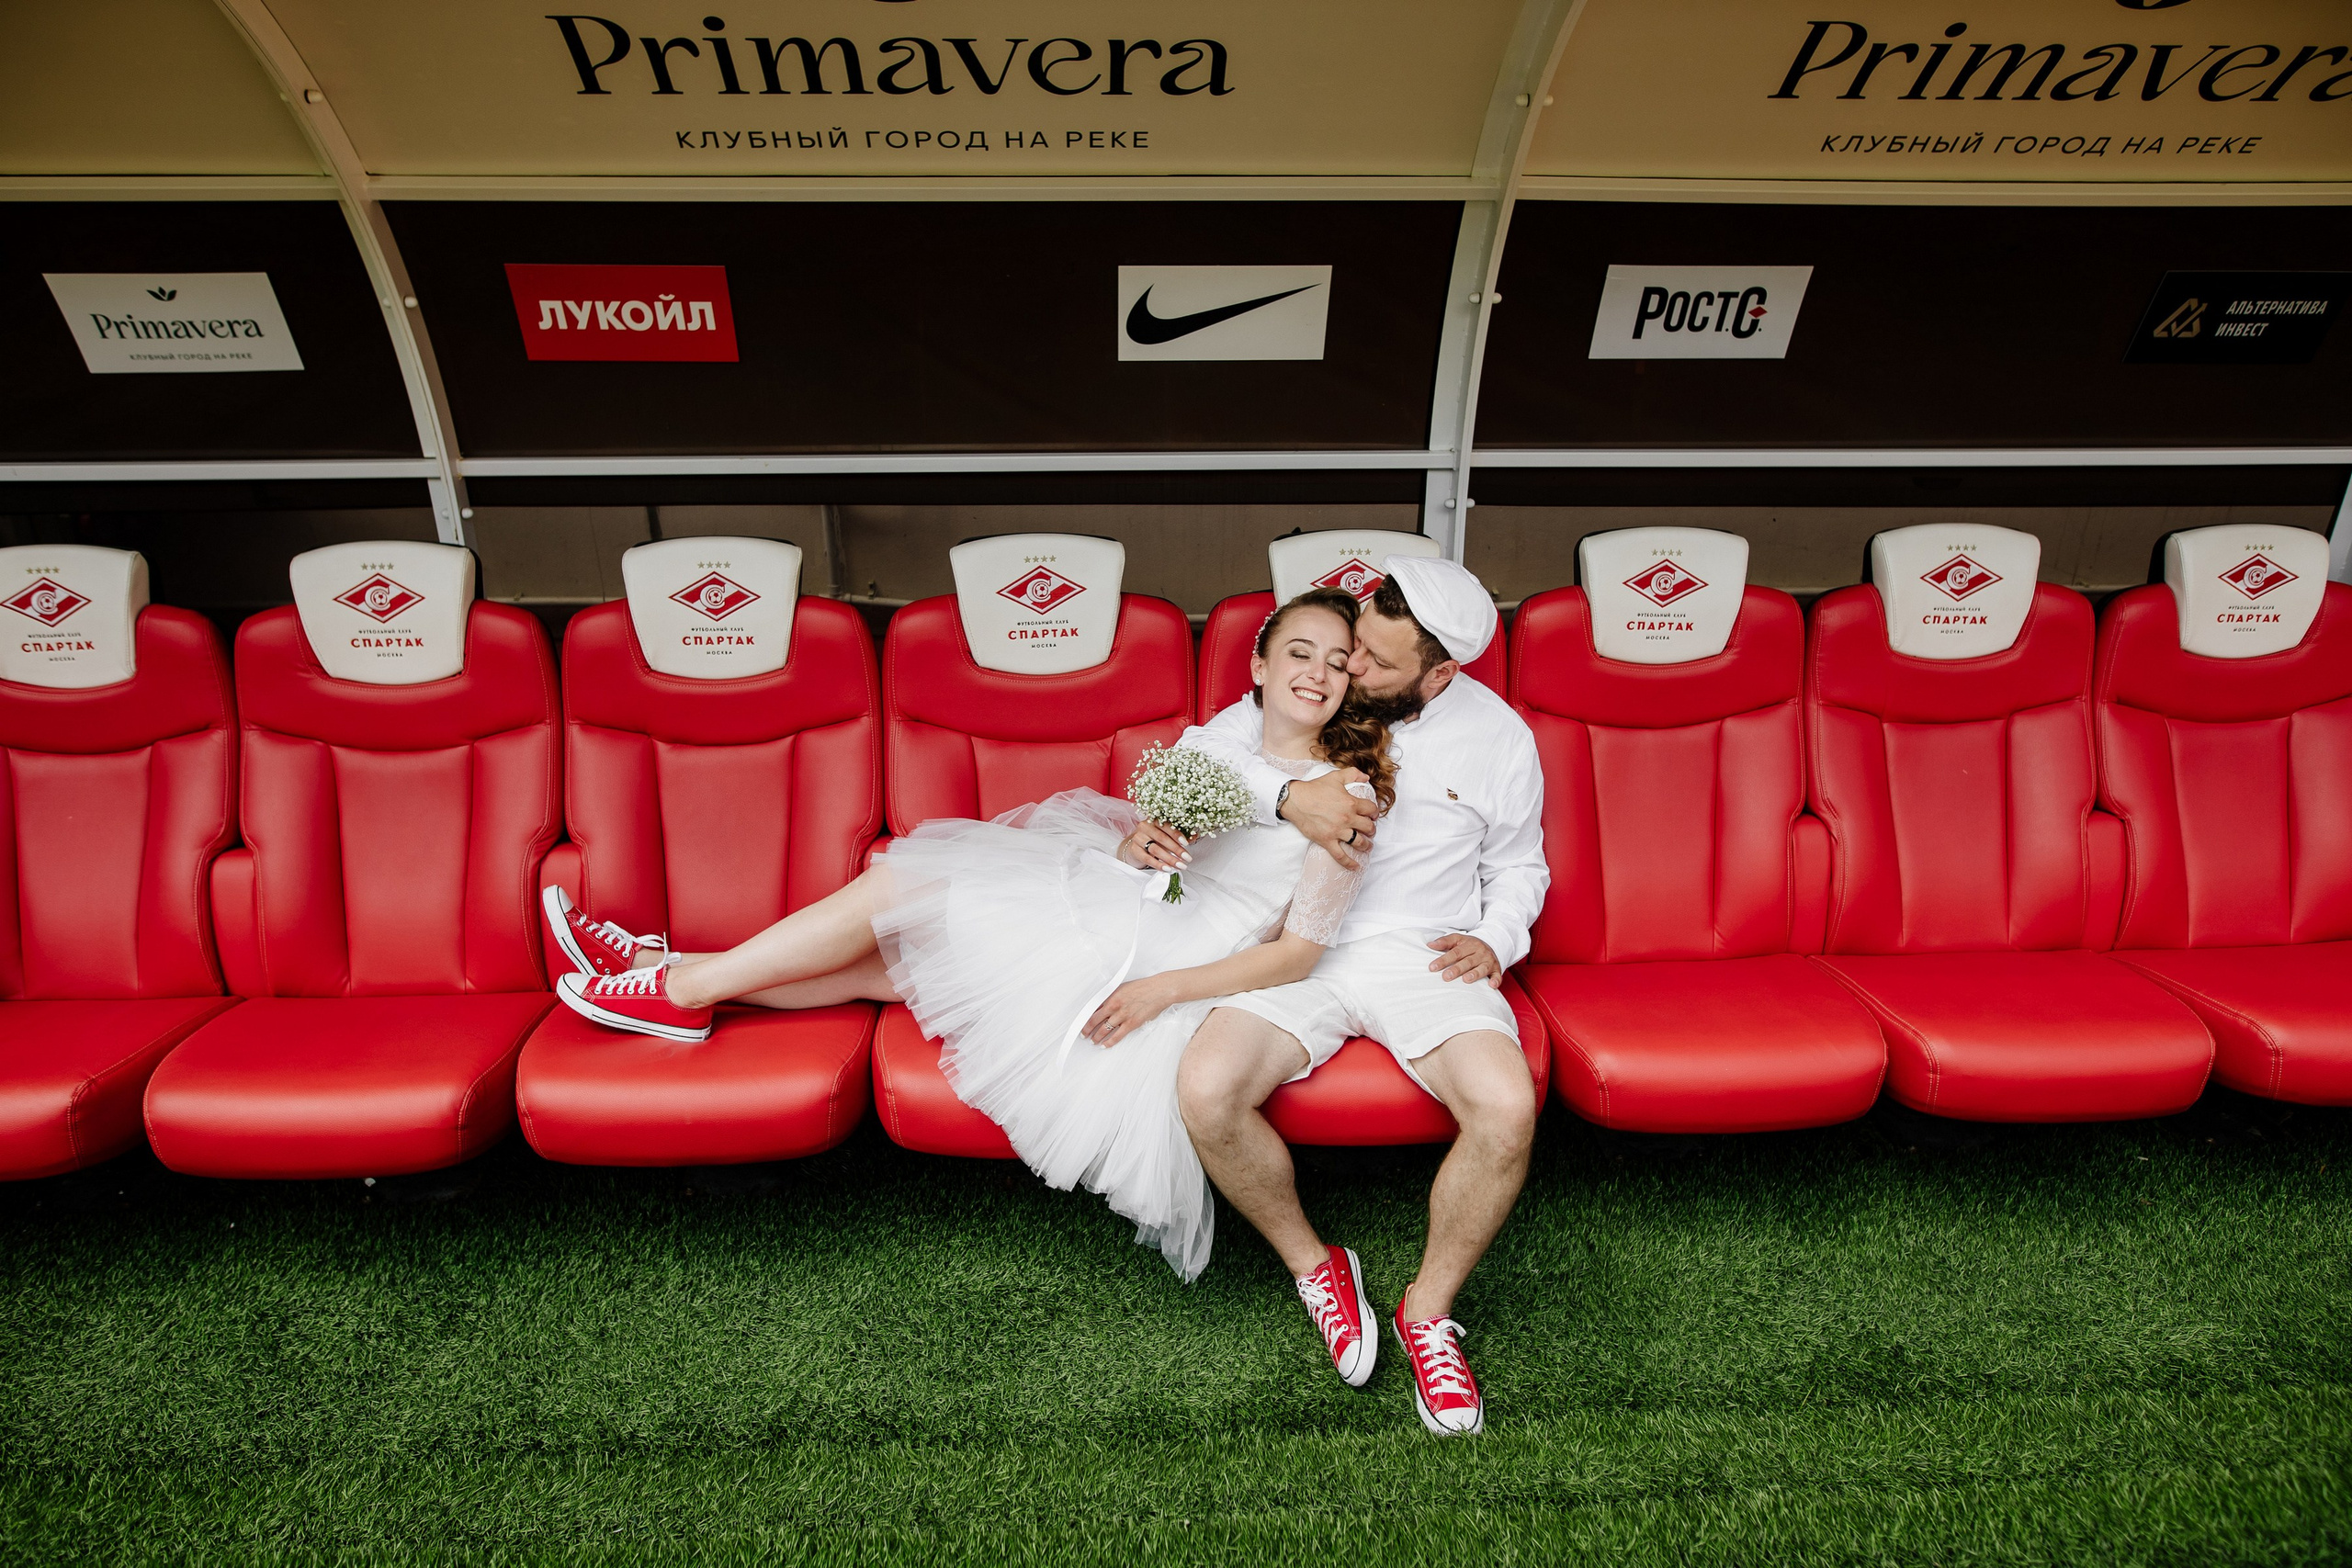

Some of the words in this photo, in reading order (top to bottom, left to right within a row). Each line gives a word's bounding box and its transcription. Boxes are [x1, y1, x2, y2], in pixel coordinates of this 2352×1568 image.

[545, 16, 1235, 96] Primavera
[676, 127, 848, 149] КЛУБНЫЙ
[865, 130, 989, 151] ГОРОД
[1005, 131, 1048, 148] НА
[1067, 131, 1148, 148] РЕКЕ
[1821, 132, 1984, 152] КЛУБНЫЙ
[1994, 136, 2111, 156] ГОРОД
[2121, 137, 2164, 153] НА
[2177, 137, 2262, 153] РЕКЕ
[538, 294, 716, 331] ЛУКОЙЛ
[2226, 301, 2327, 314] АЛЬТЕРНАТИВА
[90, 314, 264, 339] Primavera
[2215, 323, 2268, 336] ИНВЕСТ
[129, 353, 175, 361] КЛУБНЫЙ
[177, 353, 212, 361] ГОРОД
[229, 352, 254, 360] РЕКЕ
[1923, 615, 1987, 624] СПАРТАК
[2217, 615, 2280, 623] СПАРТАК
[1627, 621, 1693, 631] СПАРТАК
[1008, 628, 1079, 639] СПАРТАК
[21, 641, 94, 652] СПАРТАК
[351, 638, 424, 648] СПАРТАК
[683, 637, 754, 645] СПАРТАК
